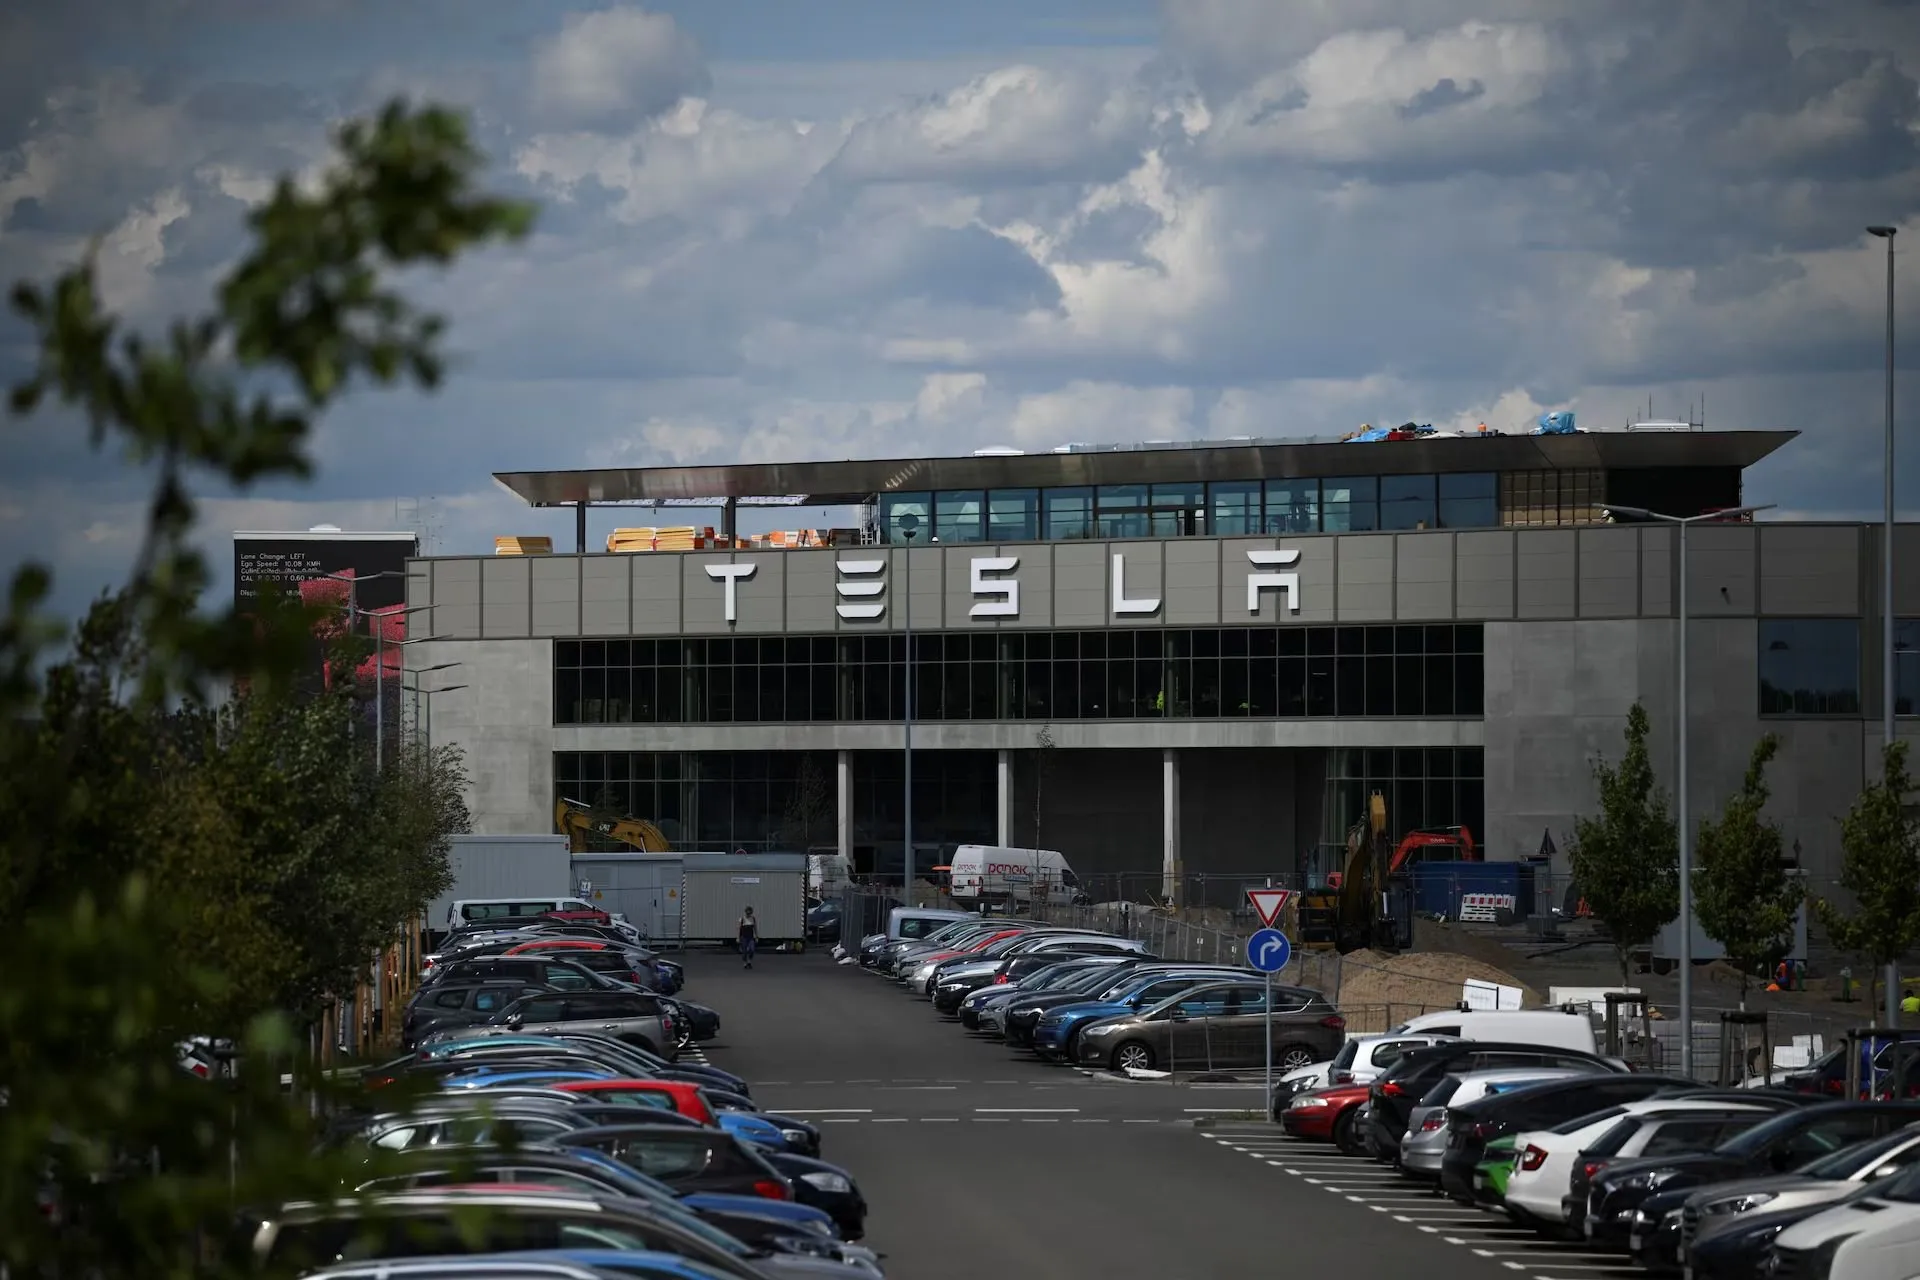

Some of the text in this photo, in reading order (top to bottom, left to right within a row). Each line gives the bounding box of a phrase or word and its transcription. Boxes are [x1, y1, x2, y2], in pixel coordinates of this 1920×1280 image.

[259, 553, 286, 561] Change:
[240, 560, 253, 568] Ego
[256, 560, 279, 568] Speed:
[704, 549, 1300, 621] TESLA
